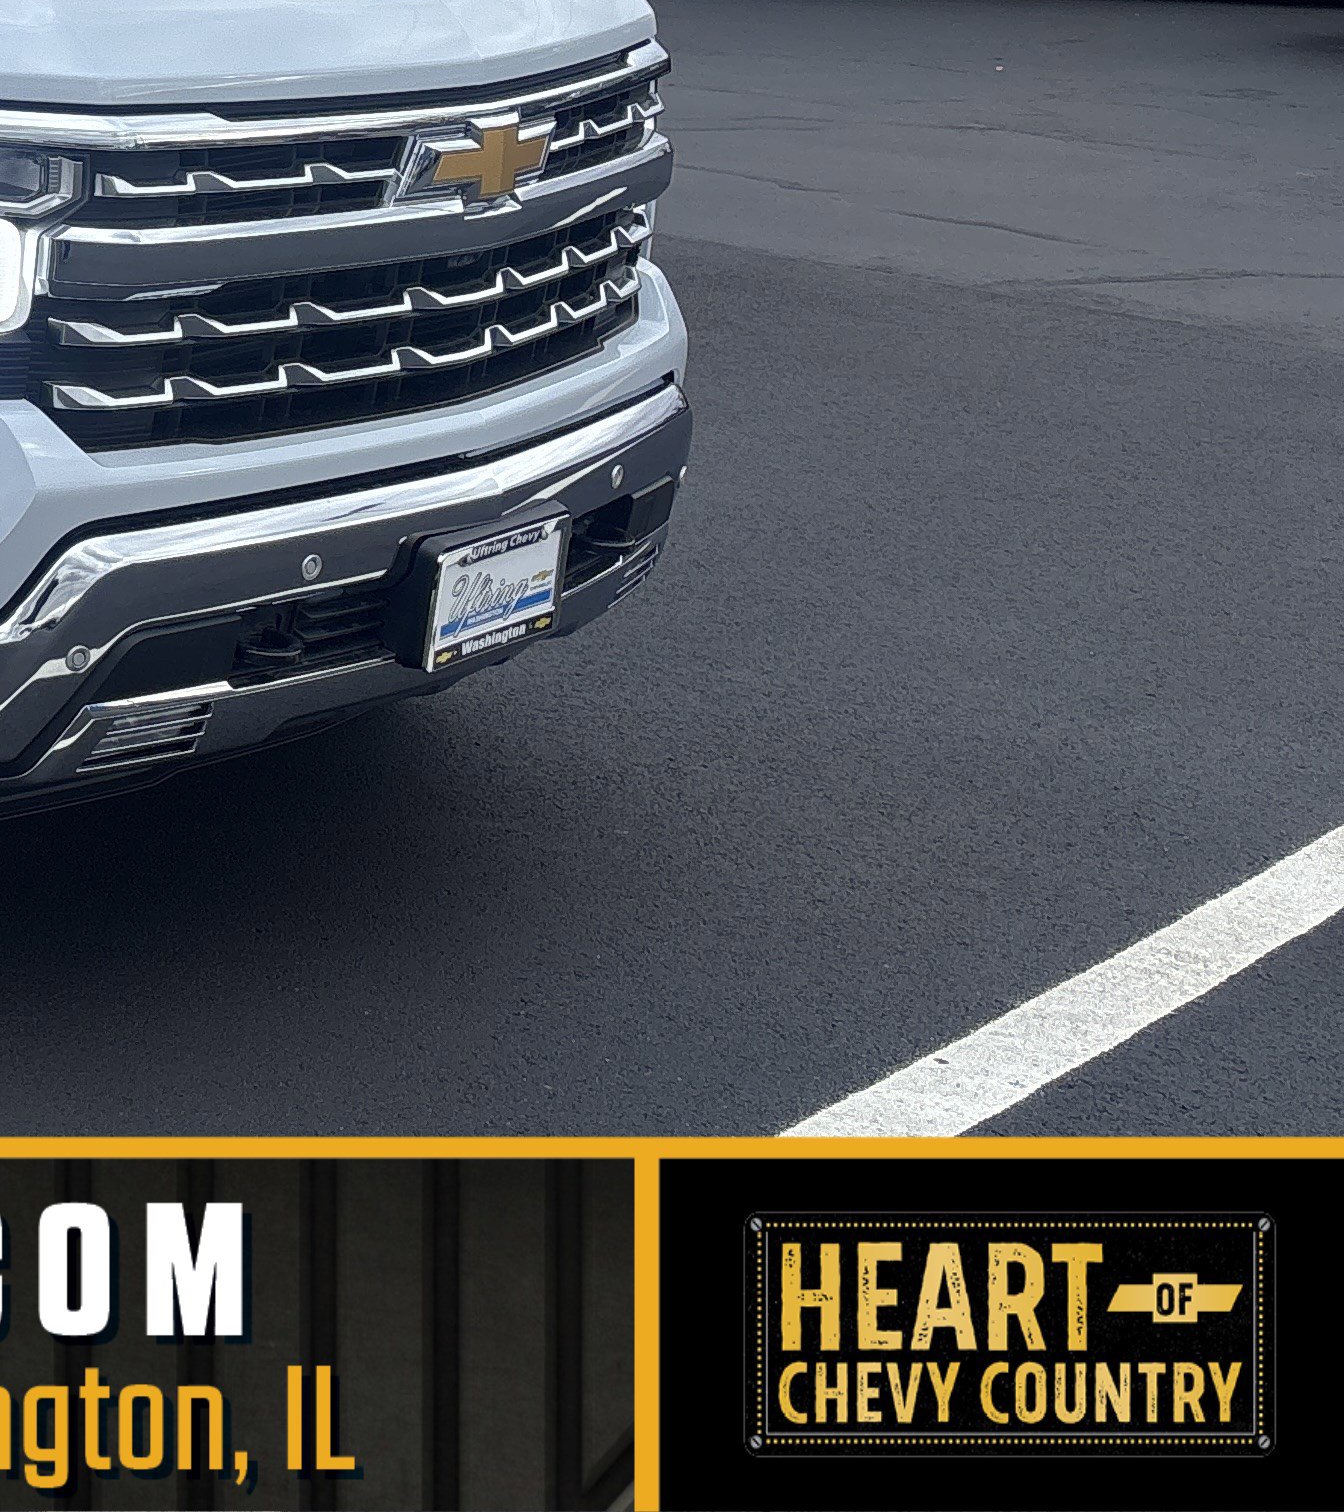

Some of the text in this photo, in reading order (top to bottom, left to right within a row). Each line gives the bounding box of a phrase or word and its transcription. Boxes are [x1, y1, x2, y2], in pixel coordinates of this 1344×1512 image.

[470, 529, 541, 558] Uftring Chevy
[461, 623, 527, 656] Washington
